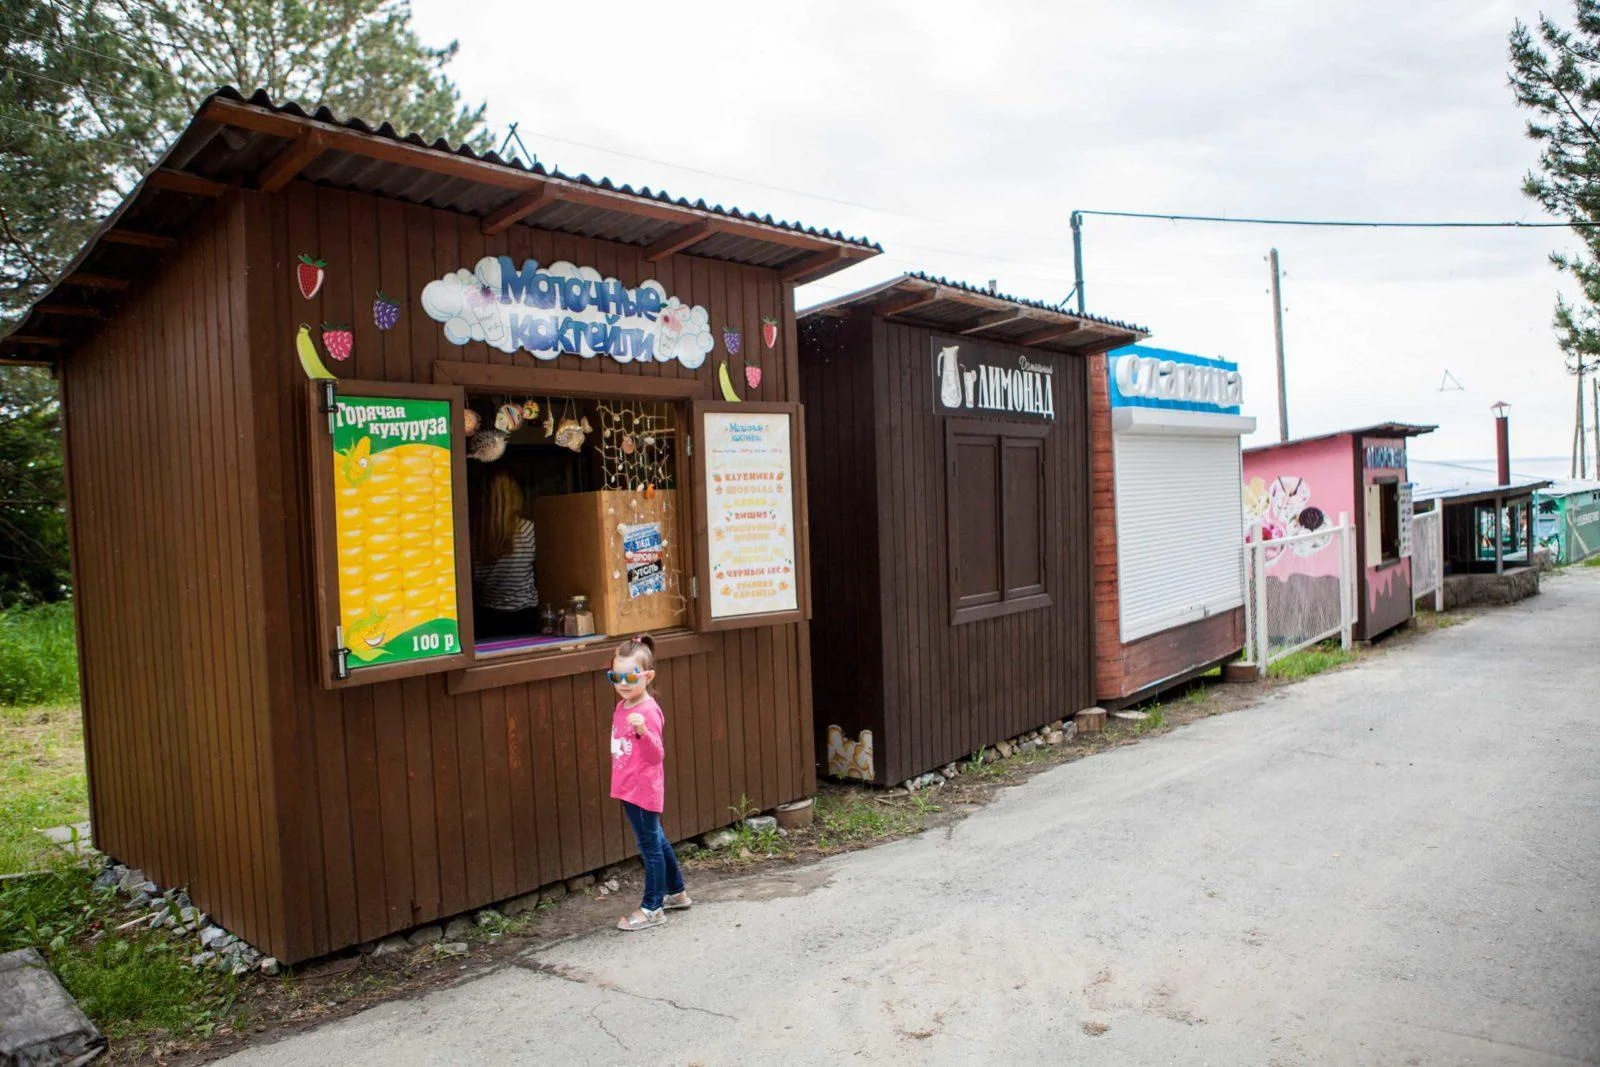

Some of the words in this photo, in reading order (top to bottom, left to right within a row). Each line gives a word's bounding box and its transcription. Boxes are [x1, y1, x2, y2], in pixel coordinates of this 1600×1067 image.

[497, 256, 661, 320] Молочные
[978, 364, 1055, 420] ЛИМОНАД
[336, 402, 406, 428] Горячая
[369, 416, 447, 441] кукуруза
[412, 633, 439, 652] 100
